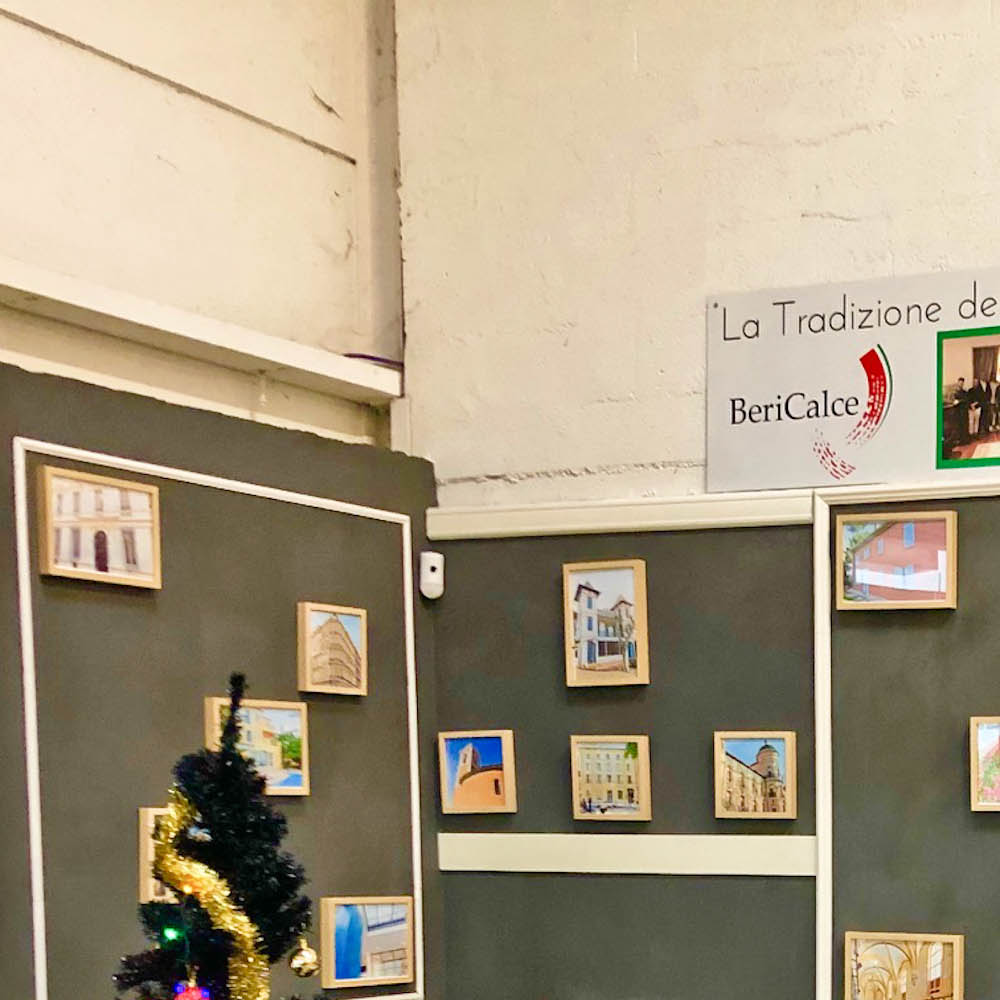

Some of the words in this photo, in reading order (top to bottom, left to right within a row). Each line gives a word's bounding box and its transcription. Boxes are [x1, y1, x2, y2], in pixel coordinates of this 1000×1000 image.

[723, 307, 760, 341] La
[772, 293, 942, 336] Tradizione
[729, 389, 860, 425] BeriCalce
